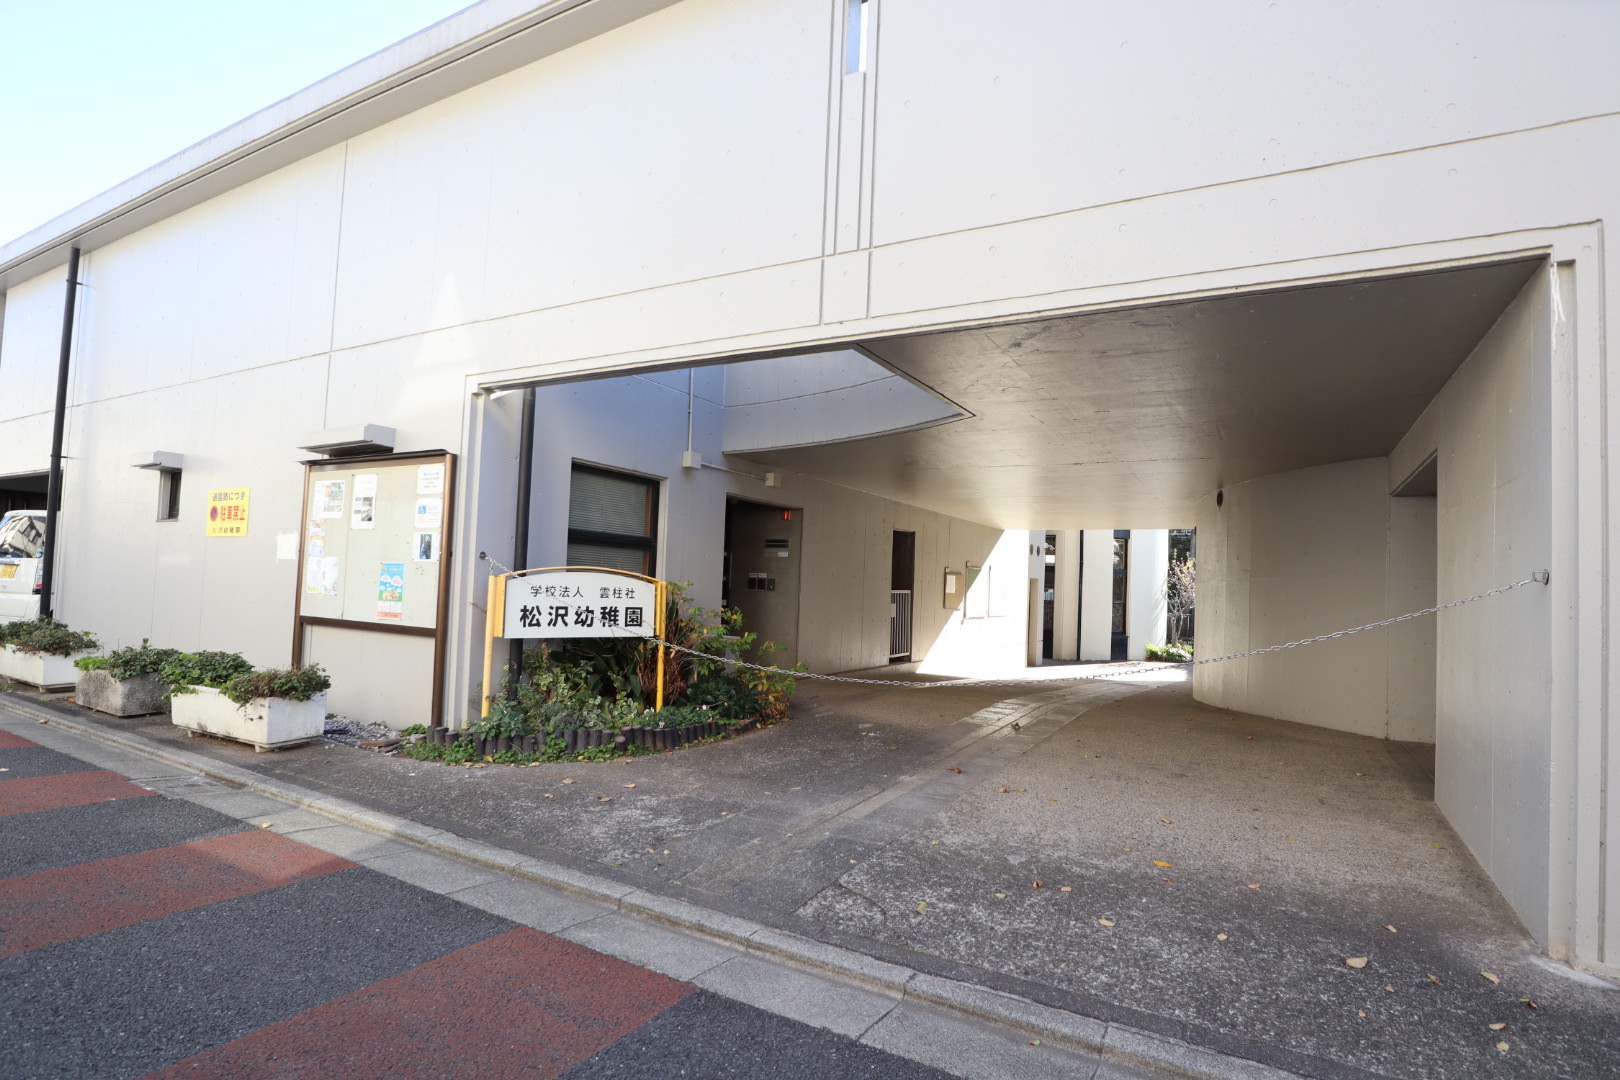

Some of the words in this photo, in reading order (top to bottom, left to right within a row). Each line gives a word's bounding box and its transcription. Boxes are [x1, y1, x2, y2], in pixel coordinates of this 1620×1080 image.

[530, 585, 584, 598] 学校法人
[599, 586, 636, 599] 雲柱社
[519, 604, 643, 628] 松沢幼稚園
